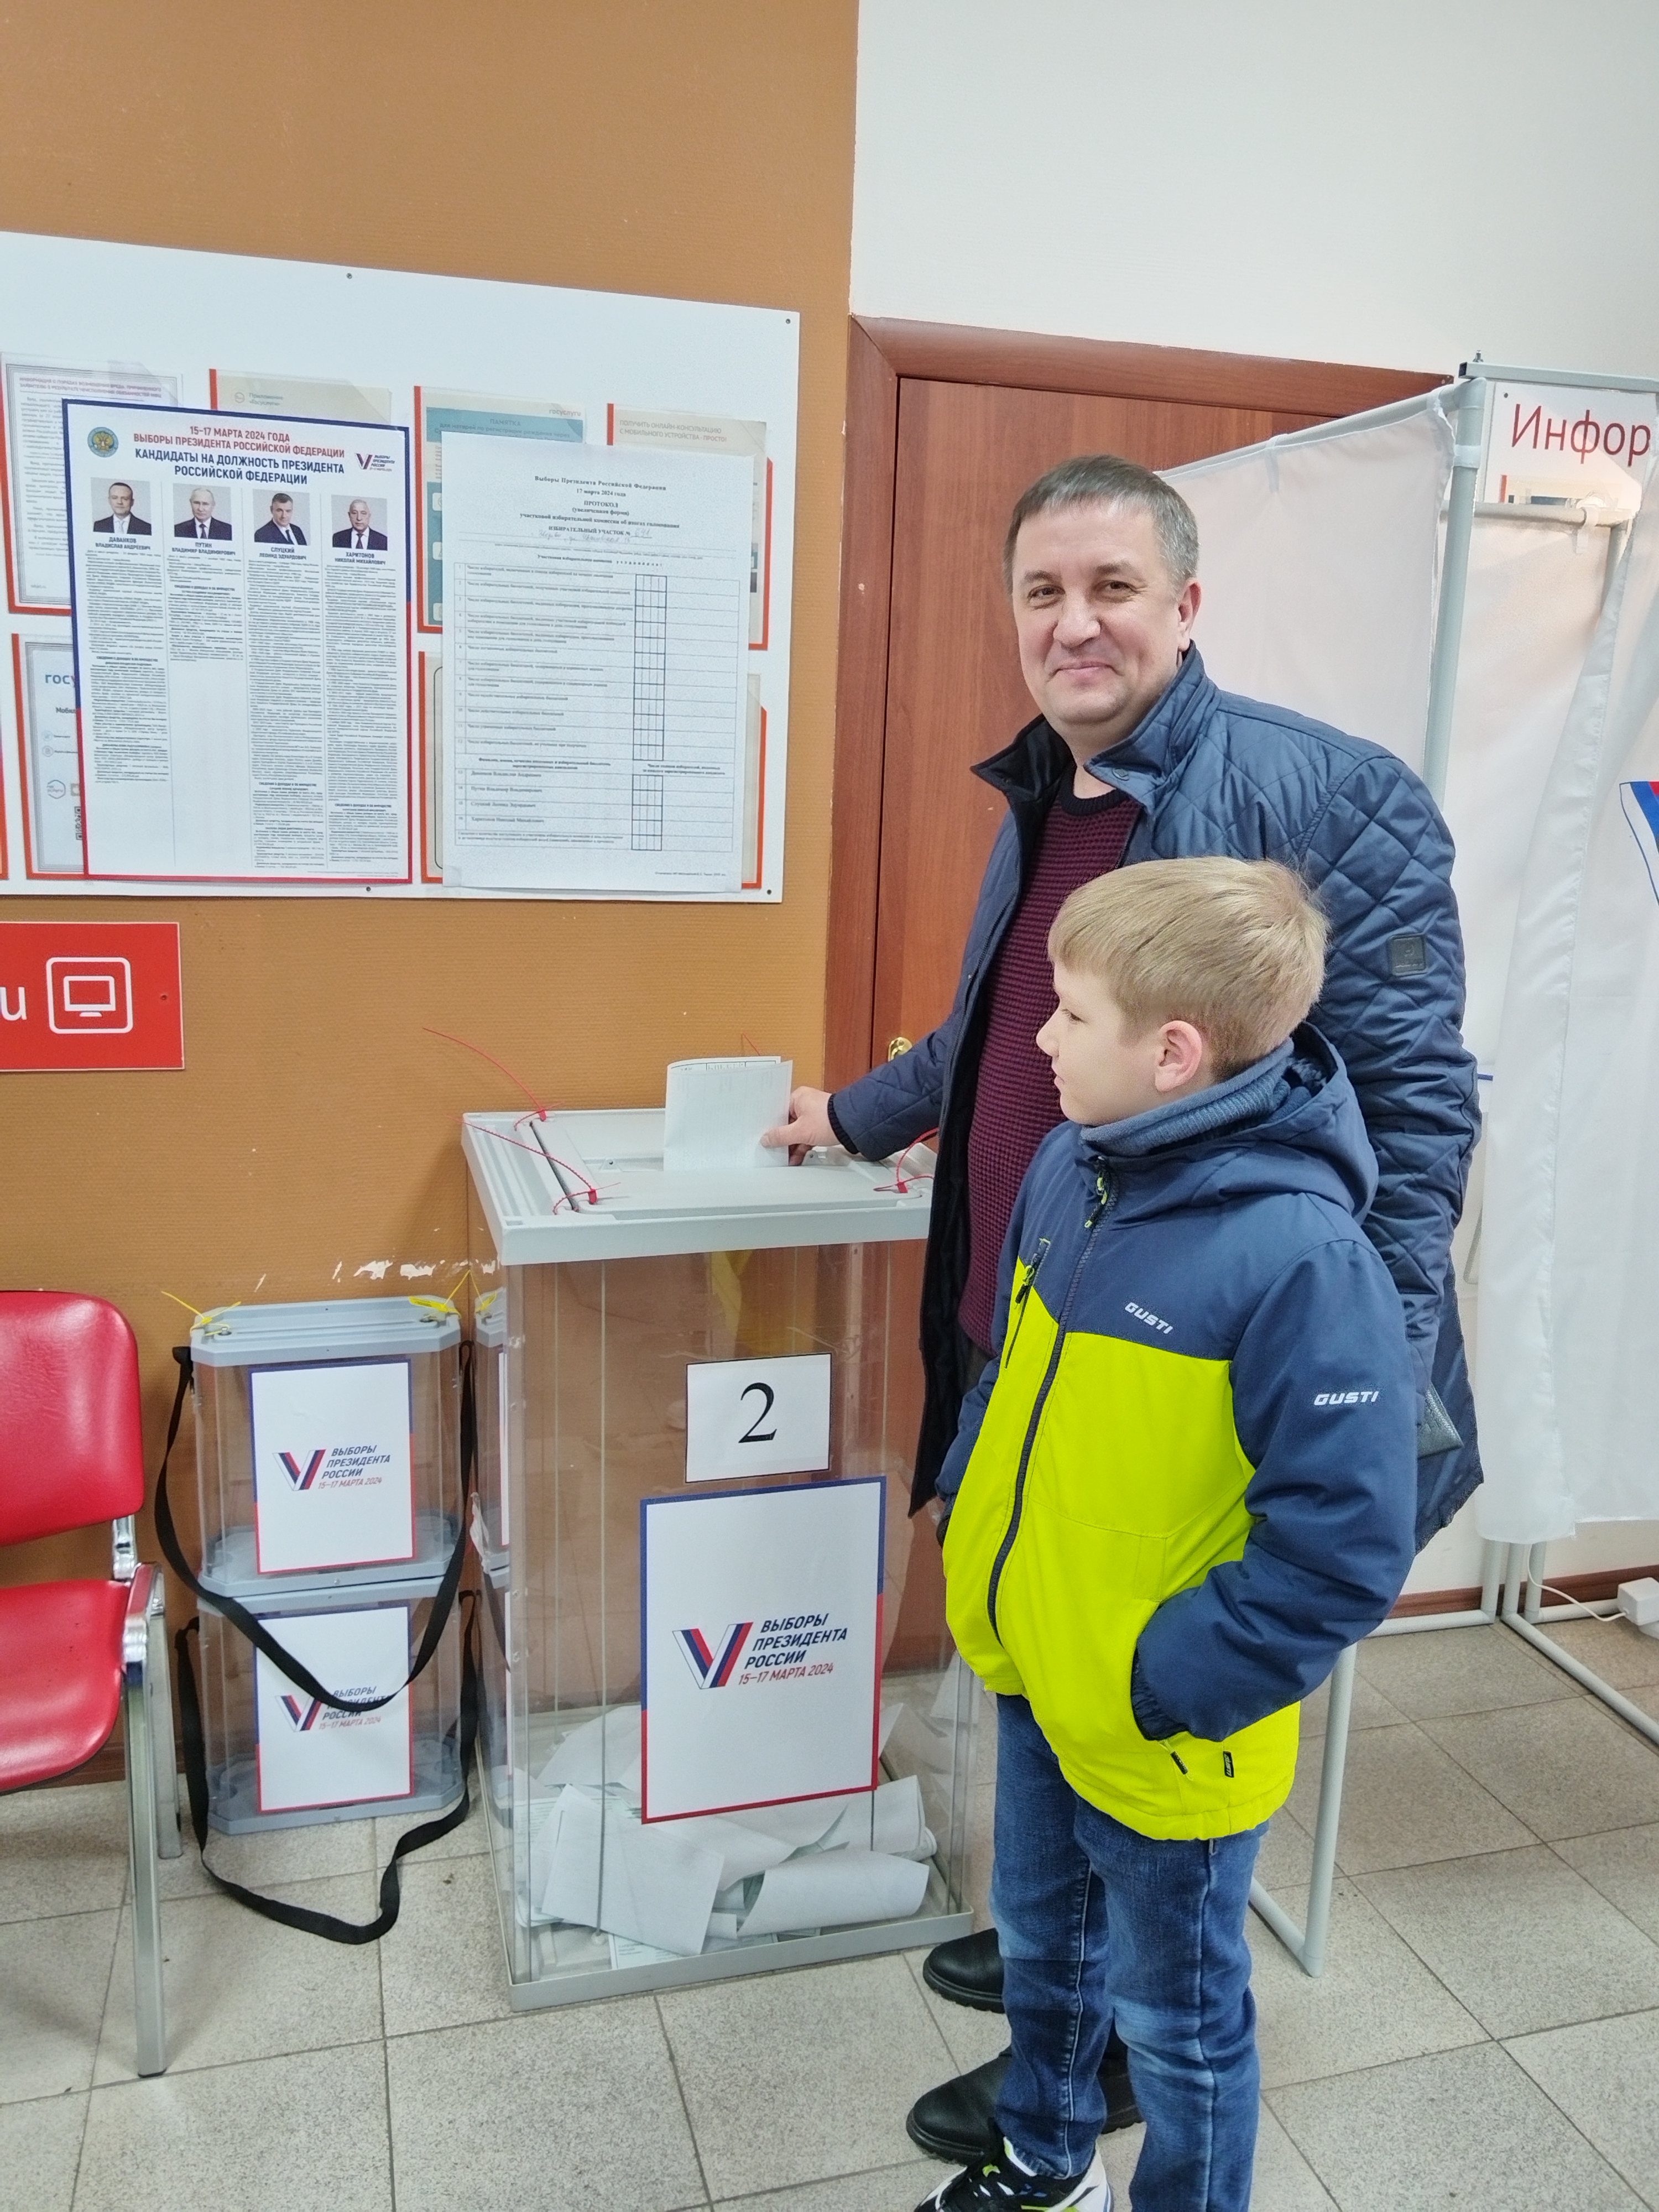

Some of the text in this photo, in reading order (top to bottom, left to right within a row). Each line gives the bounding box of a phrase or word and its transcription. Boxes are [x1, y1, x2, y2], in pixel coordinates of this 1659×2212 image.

[190, 426, 290, 442] 15-17 МАРТА 2024 ГОДА
[624, 429, 663, 437] МОБИЛЬНОГО
[664, 431, 699, 440] УСТРОЙСТВА
[1511, 404, 1651, 467] Инфор
[134, 434, 345, 458] ВЫБОРЫ ПРЕЗИДЕНТА РОССИЙСКОЙ ФЕДЕРАЦИИ
[135, 448, 345, 473] КАНДИДАТЫ НА ДОЛЖНОСТЬ ПРЕЗИДЕНТА
[174, 465, 307, 484] РОССИЙСКОЙ ФЕДЕРАЦИИ
[561, 478, 596, 486] Президента
[598, 480, 632, 488] Российской
[549, 525, 597, 534] ИЗБИРАТЕЛЬНЫЙ
[1125, 1302, 1173, 1334] GUSTI
[1314, 1391, 1379, 1406] GUSTI
[738, 1383, 778, 1443] 2
[331, 1445, 377, 1457] ВЫБОРЫ
[326, 1454, 391, 1468] ПРЕЗИДЕНТА
[321, 1468, 363, 1479] РОССИИ
[338, 1479, 363, 1488] МАРТА
[364, 1477, 382, 1485] 2024
[760, 1613, 829, 1633] ВЫБОРЫ
[752, 1627, 848, 1651] ПРЕЗИДЕНТА
[744, 1650, 807, 1670] РОССИИ
[769, 1666, 806, 1681] МАРТА
[807, 1662, 833, 1676] 2024
[333, 1686, 377, 1697] ВЫБОРЫ
[339, 1718, 362, 1727] МАРТА
[364, 1716, 382, 1725] 2024
